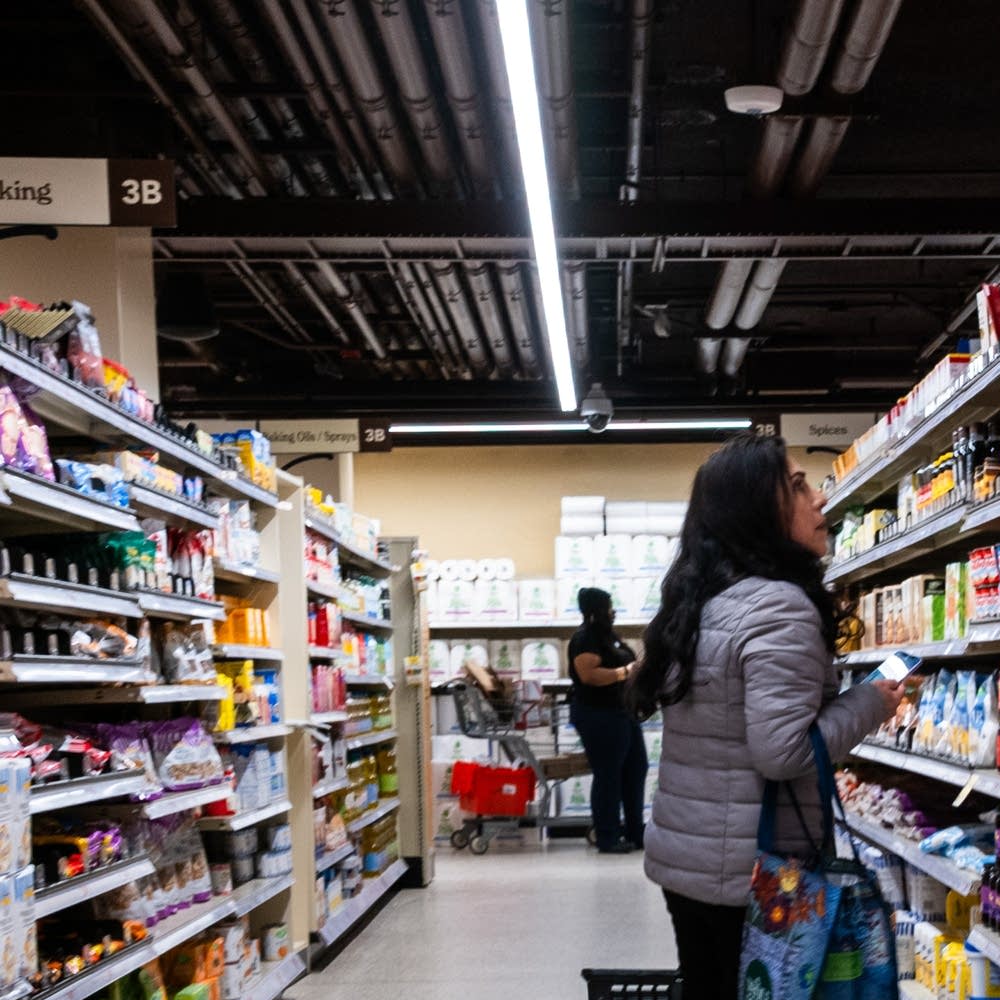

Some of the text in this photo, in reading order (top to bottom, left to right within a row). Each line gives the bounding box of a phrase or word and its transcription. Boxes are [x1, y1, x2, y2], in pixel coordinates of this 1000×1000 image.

[121, 179, 162, 205] 3B
[364, 428, 385, 442] 3B
[755, 424, 776, 437] 3B
[809, 424, 848, 438] Spices
